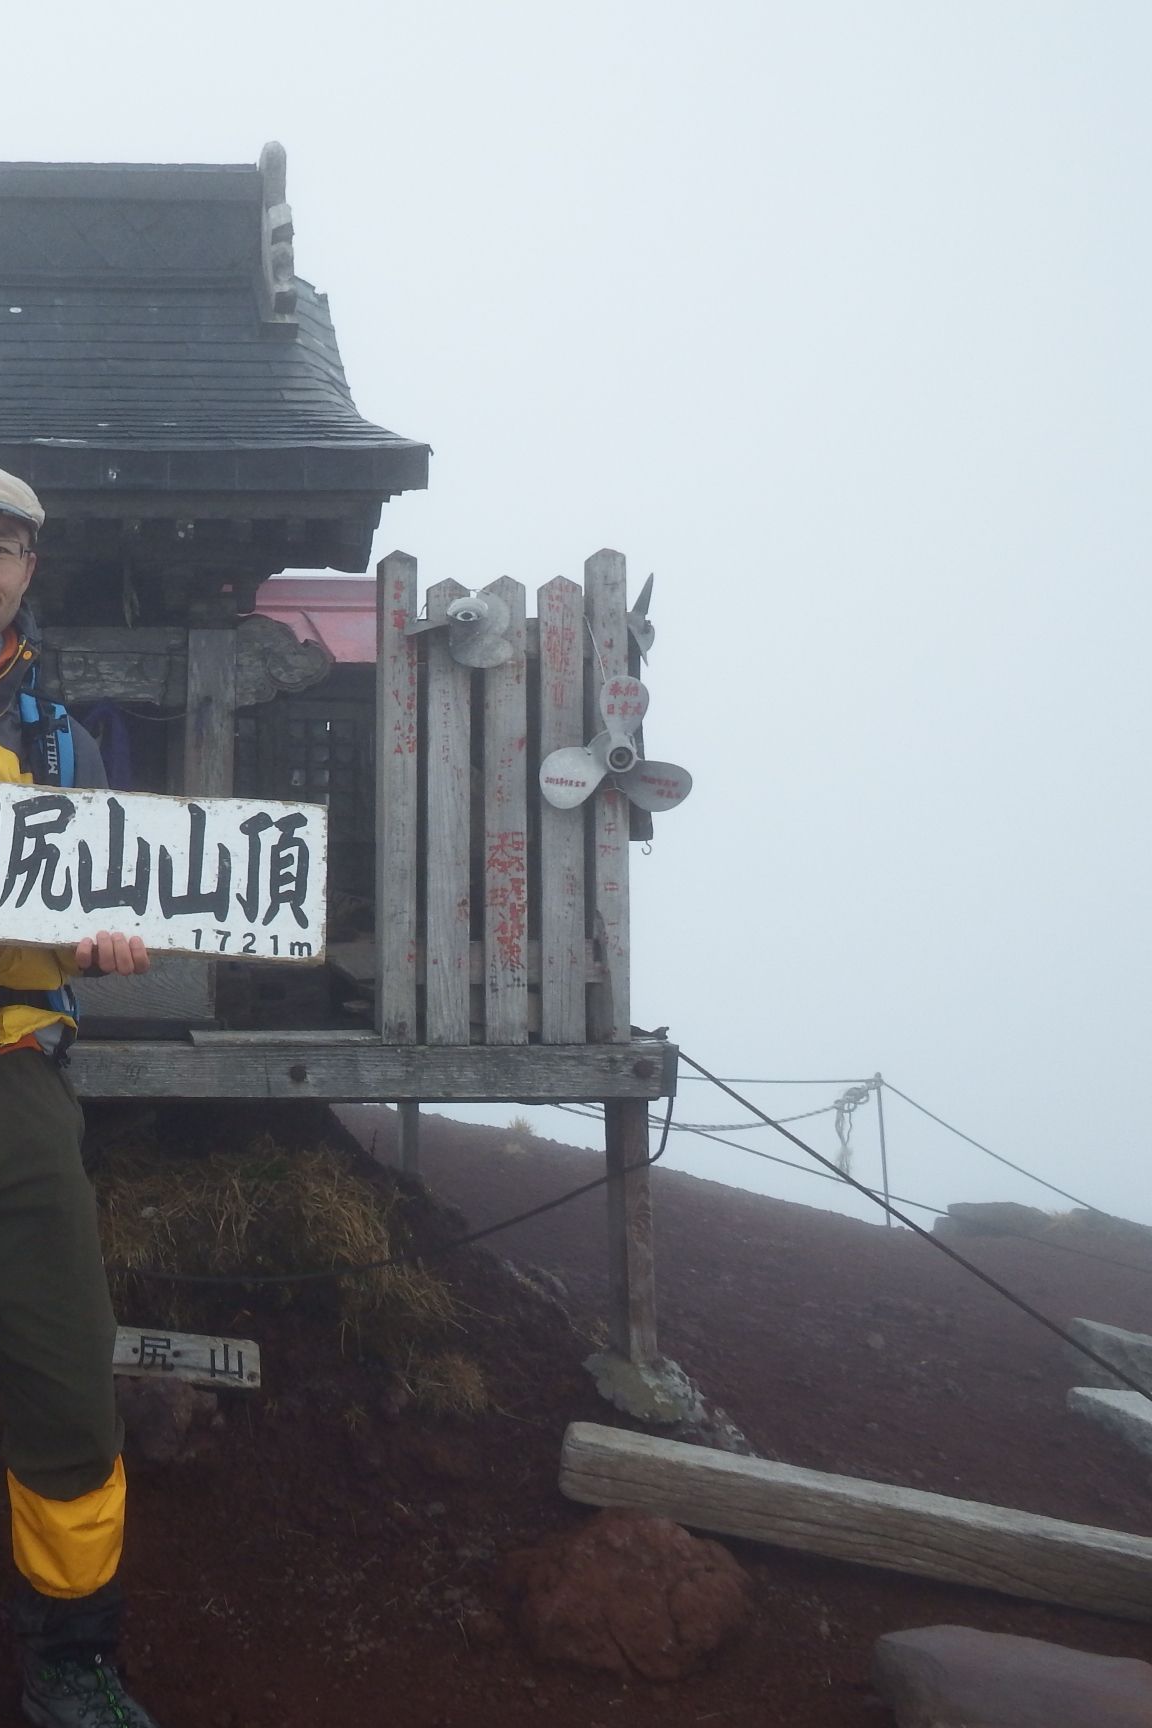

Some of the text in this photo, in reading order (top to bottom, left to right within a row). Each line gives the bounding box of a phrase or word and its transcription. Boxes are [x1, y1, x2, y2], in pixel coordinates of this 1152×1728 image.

[46, 732, 58, 775] MILLE
[192, 928, 312, 957] 1721m
[138, 1335, 244, 1379] 尻山
